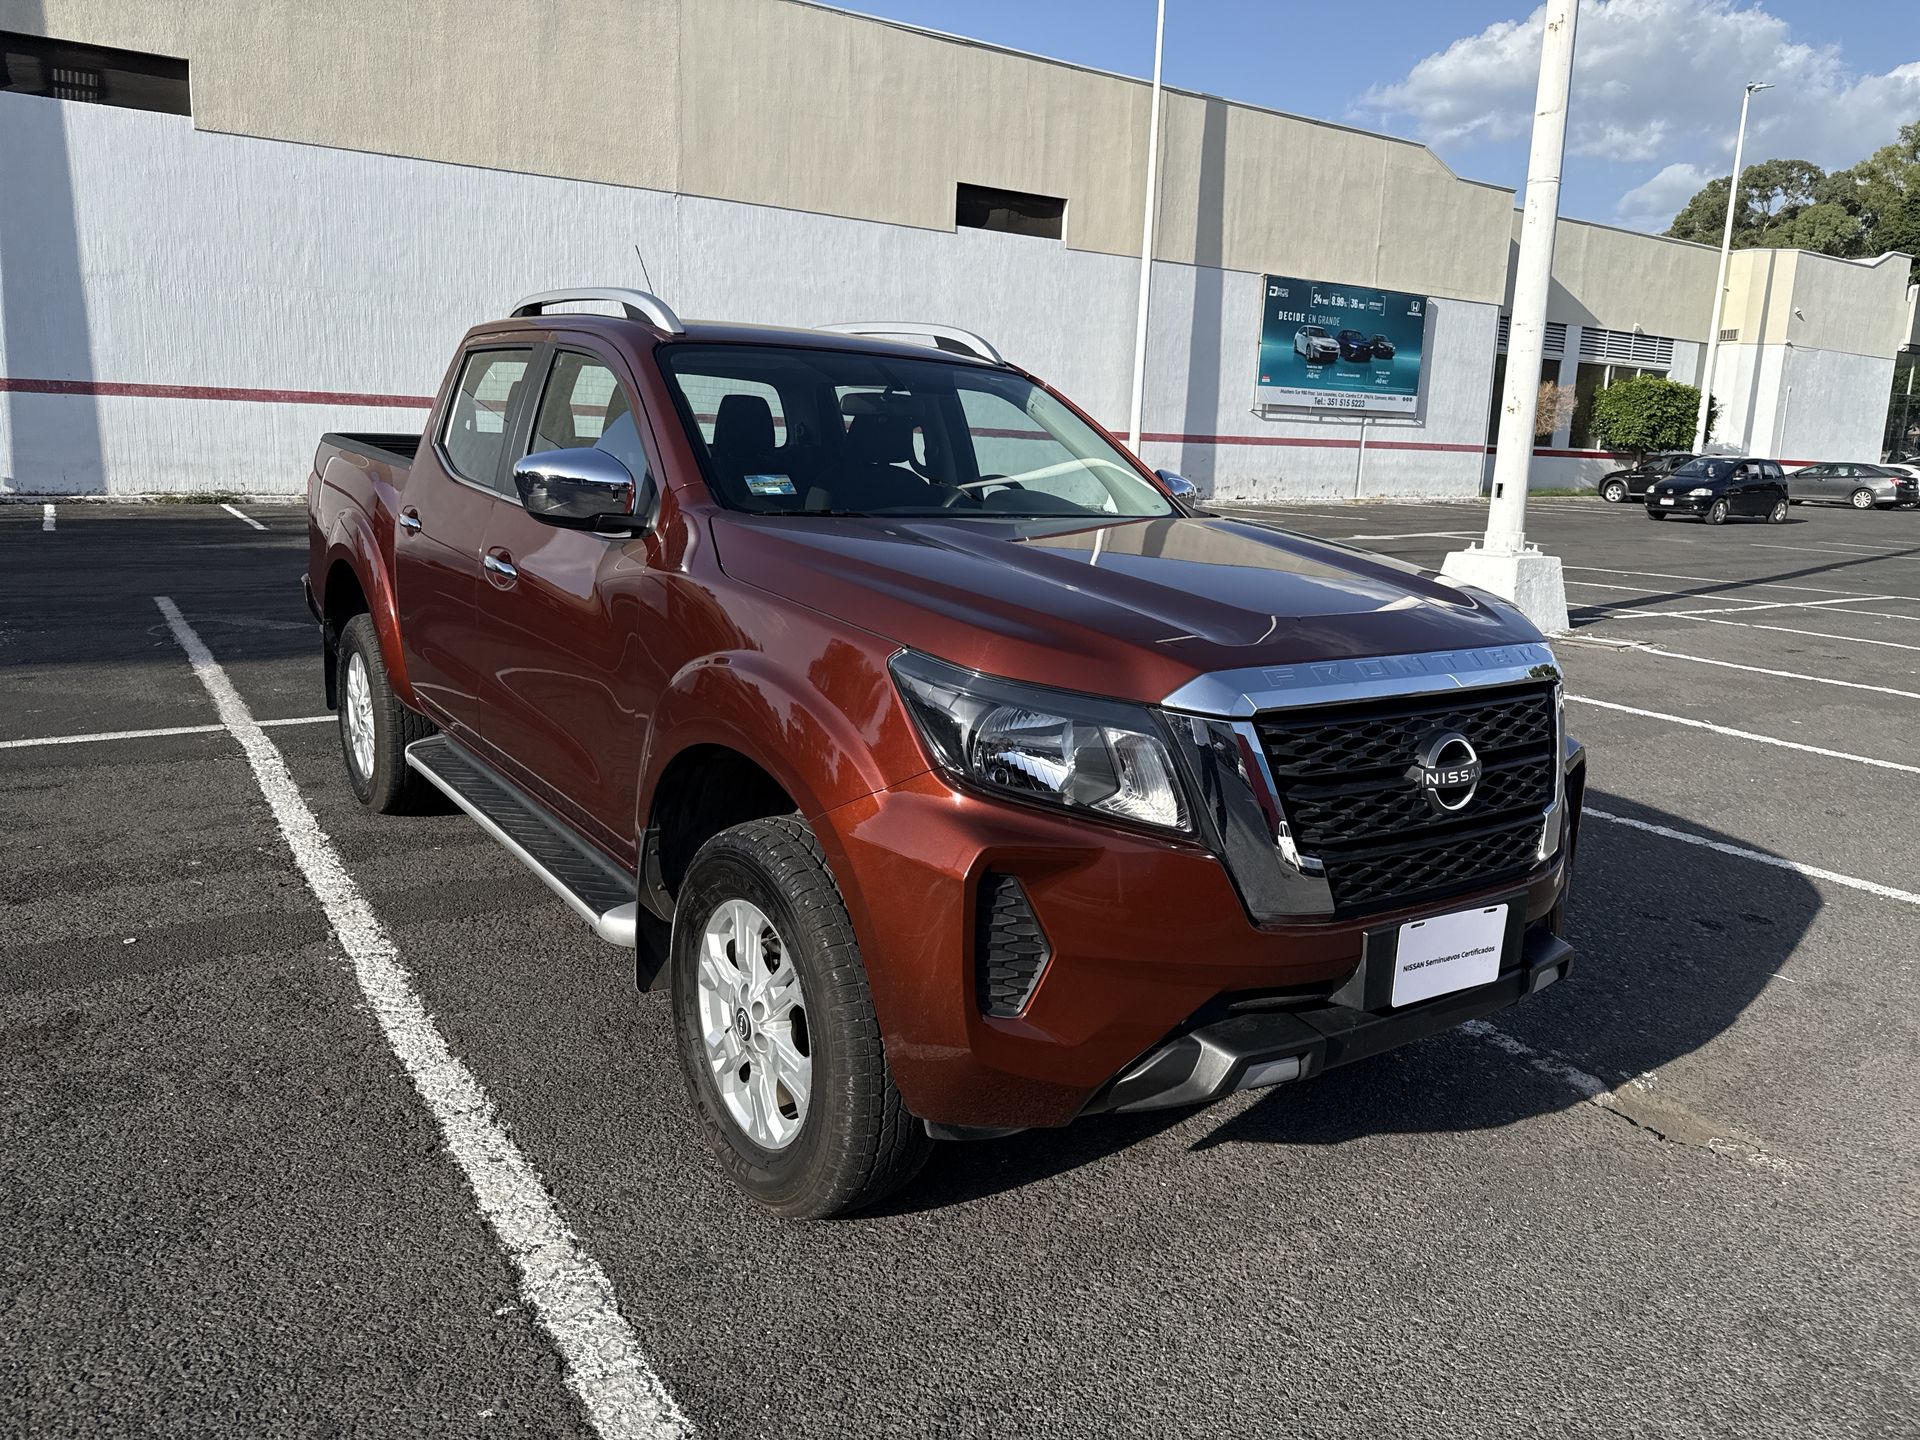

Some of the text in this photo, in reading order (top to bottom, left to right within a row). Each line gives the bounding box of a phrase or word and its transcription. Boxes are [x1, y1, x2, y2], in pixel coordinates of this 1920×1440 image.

[1313, 293, 1322, 305] 24
[1278, 310, 1341, 326] DECIDE EN GRANDE
[1327, 398, 1338, 407] 351
[1339, 398, 1350, 407] 515
[1351, 399, 1366, 408] 5223
[1262, 643, 1541, 688] FRONTIER
[1402, 945, 1495, 972] NISSAN Seminuevos Certificados
